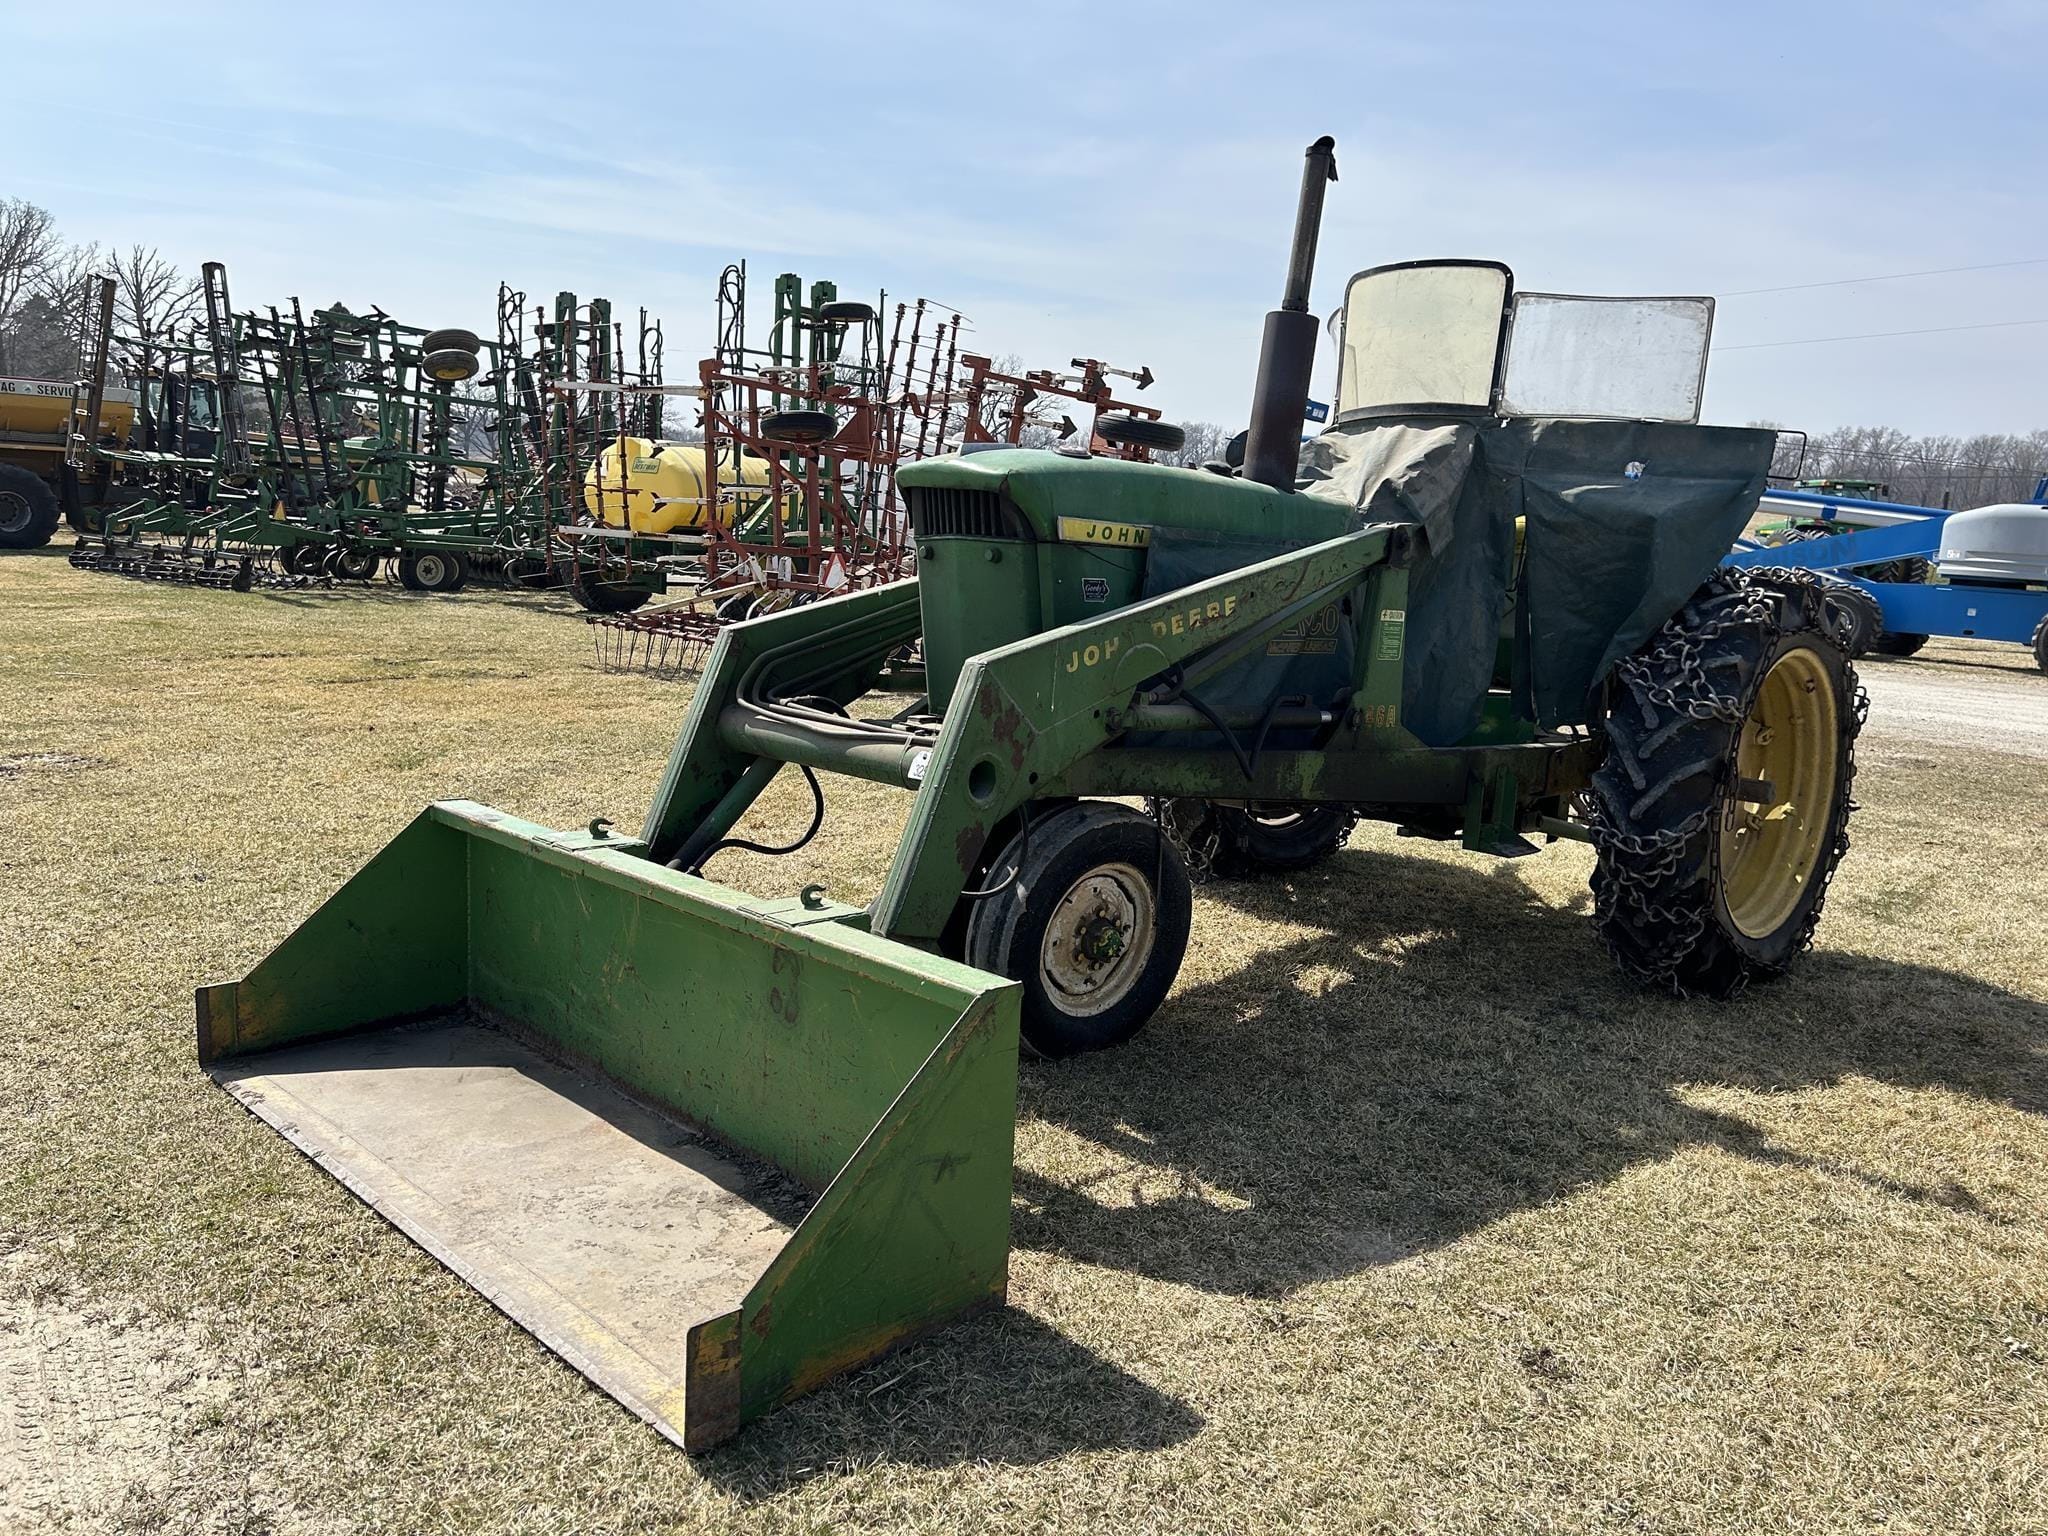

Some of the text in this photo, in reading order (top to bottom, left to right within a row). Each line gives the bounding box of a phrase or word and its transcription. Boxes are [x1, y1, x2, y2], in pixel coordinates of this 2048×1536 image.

[1, 382, 79, 397] AG SERVIC
[1086, 524, 1145, 544] JOHN
[1066, 637, 1120, 673] JOH
[1151, 595, 1237, 638] DEERE
